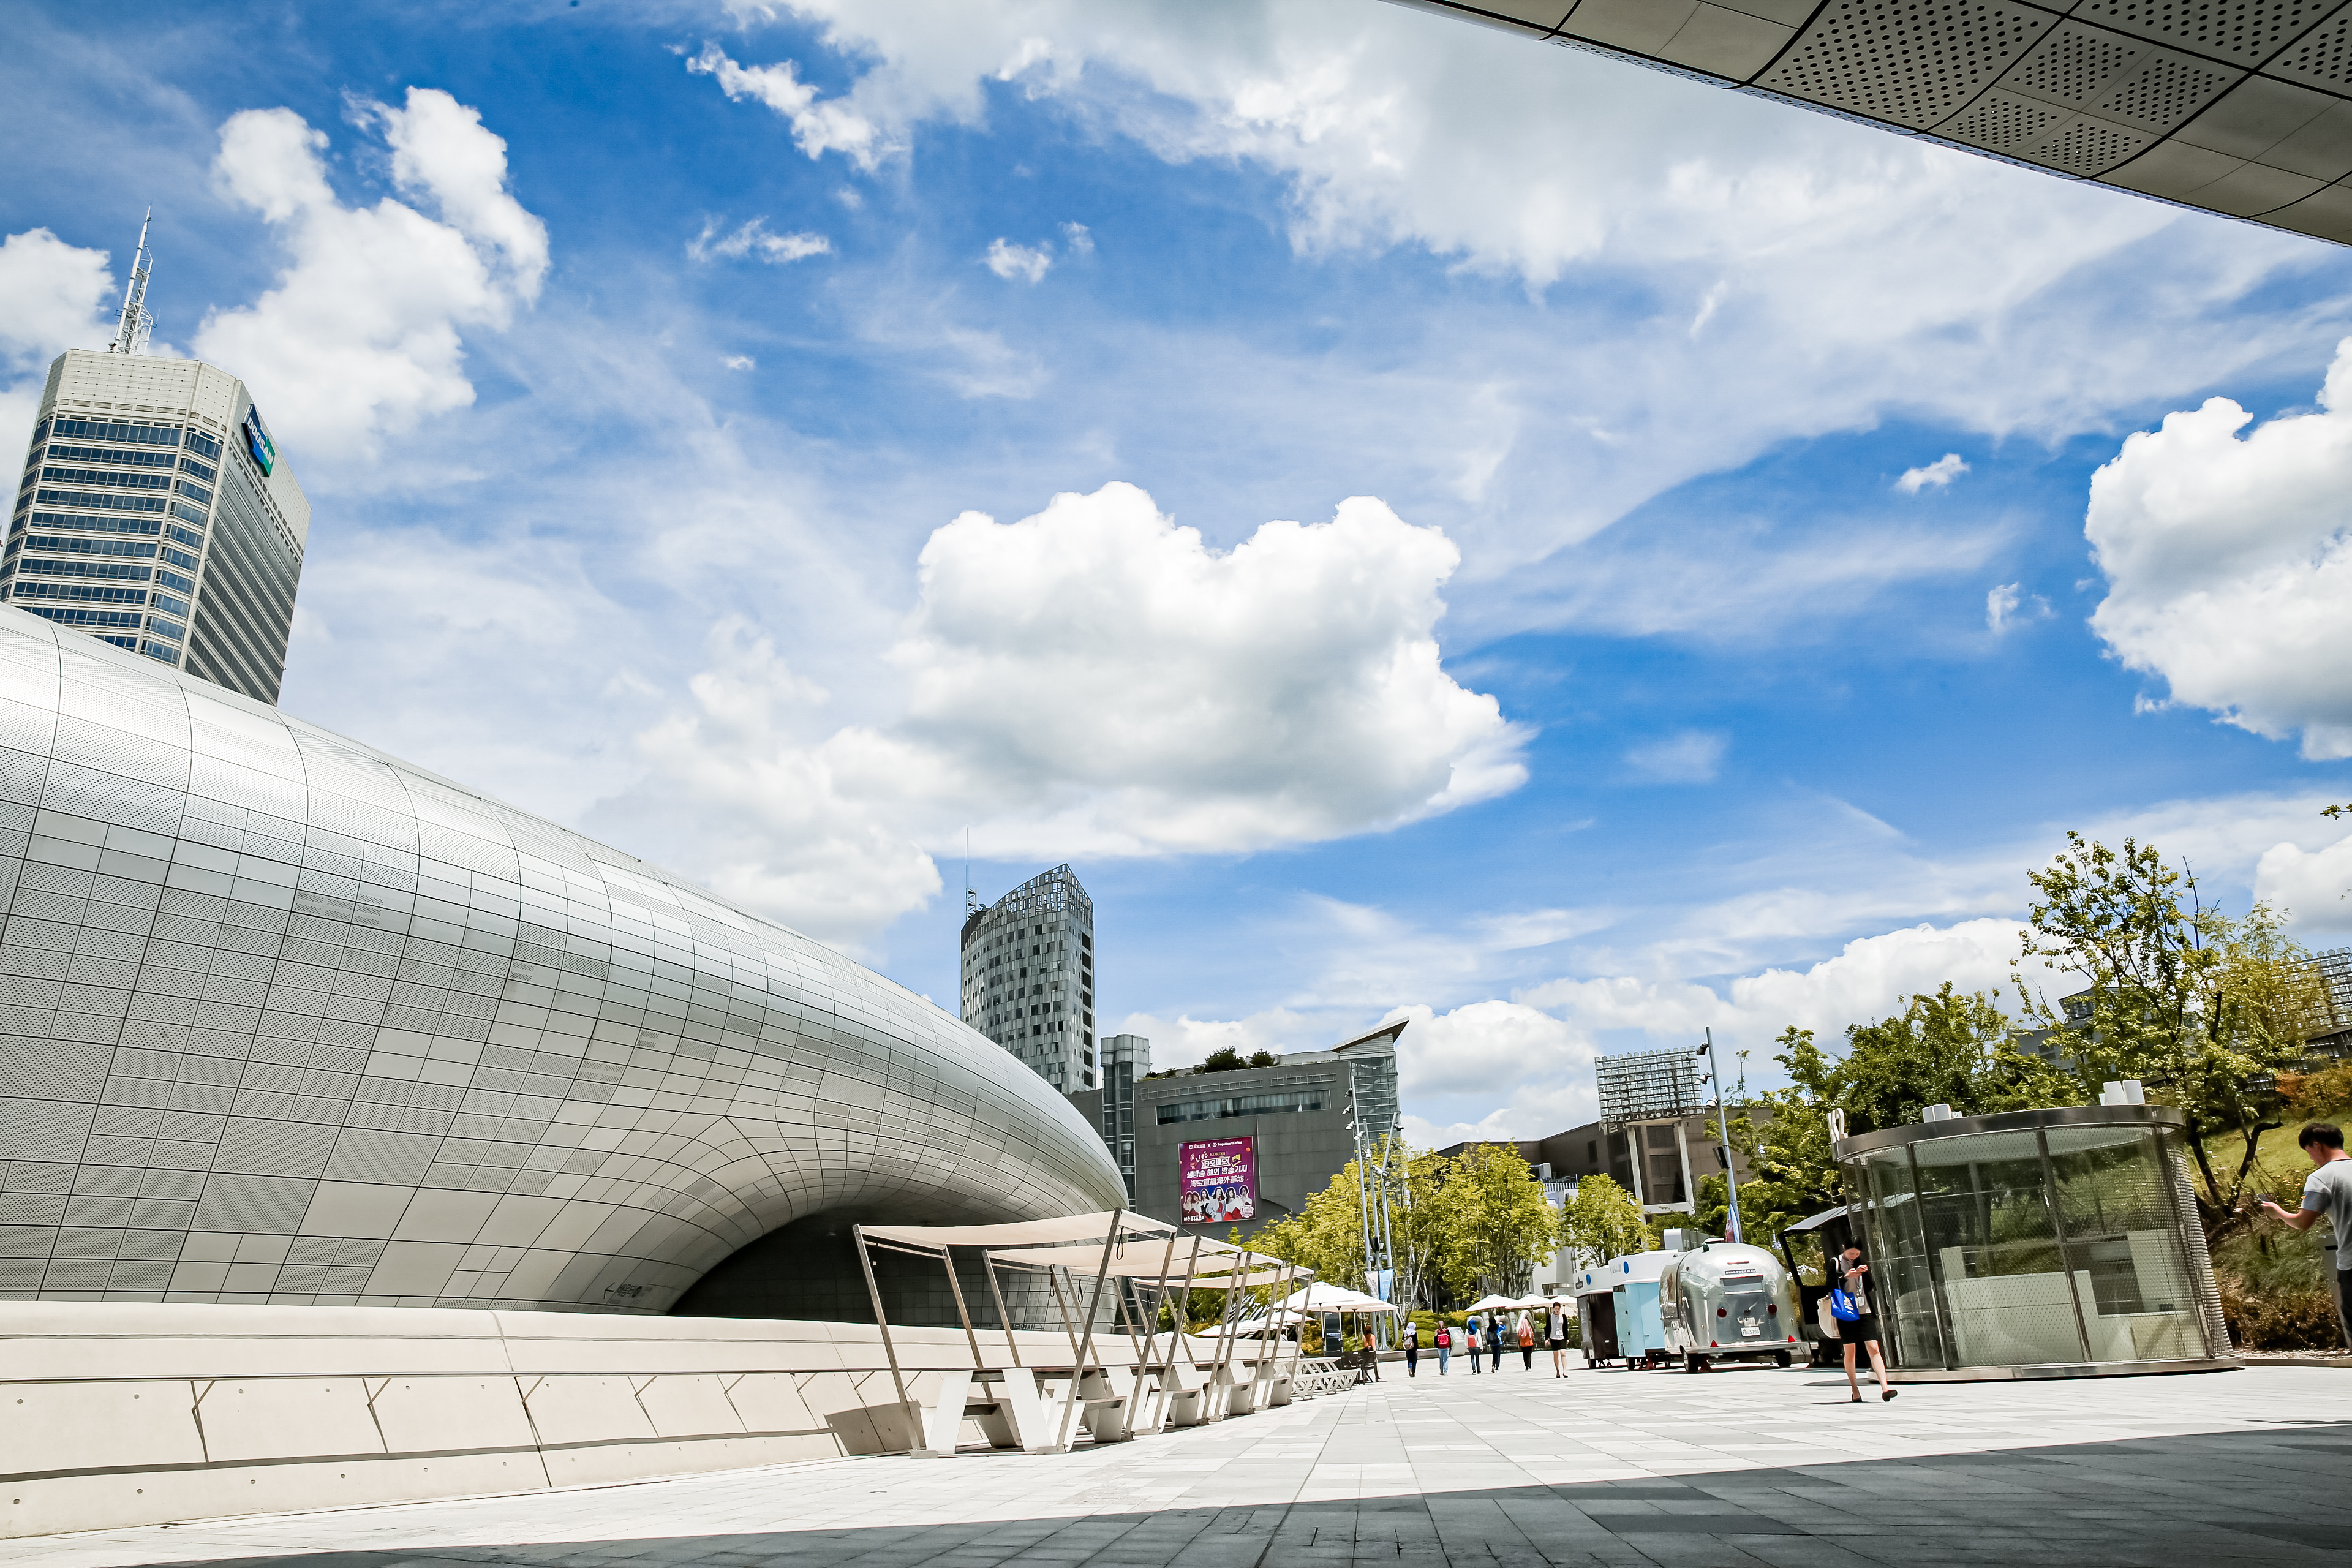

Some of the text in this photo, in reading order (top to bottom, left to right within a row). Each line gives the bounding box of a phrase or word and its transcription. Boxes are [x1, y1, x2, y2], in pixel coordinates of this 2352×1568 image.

[247, 417, 274, 465] DOOSAN
[1195, 1151, 1208, 1163] LIVE
[1186, 1169, 1205, 1179] 생방송
[1207, 1167, 1220, 1176] 해외
